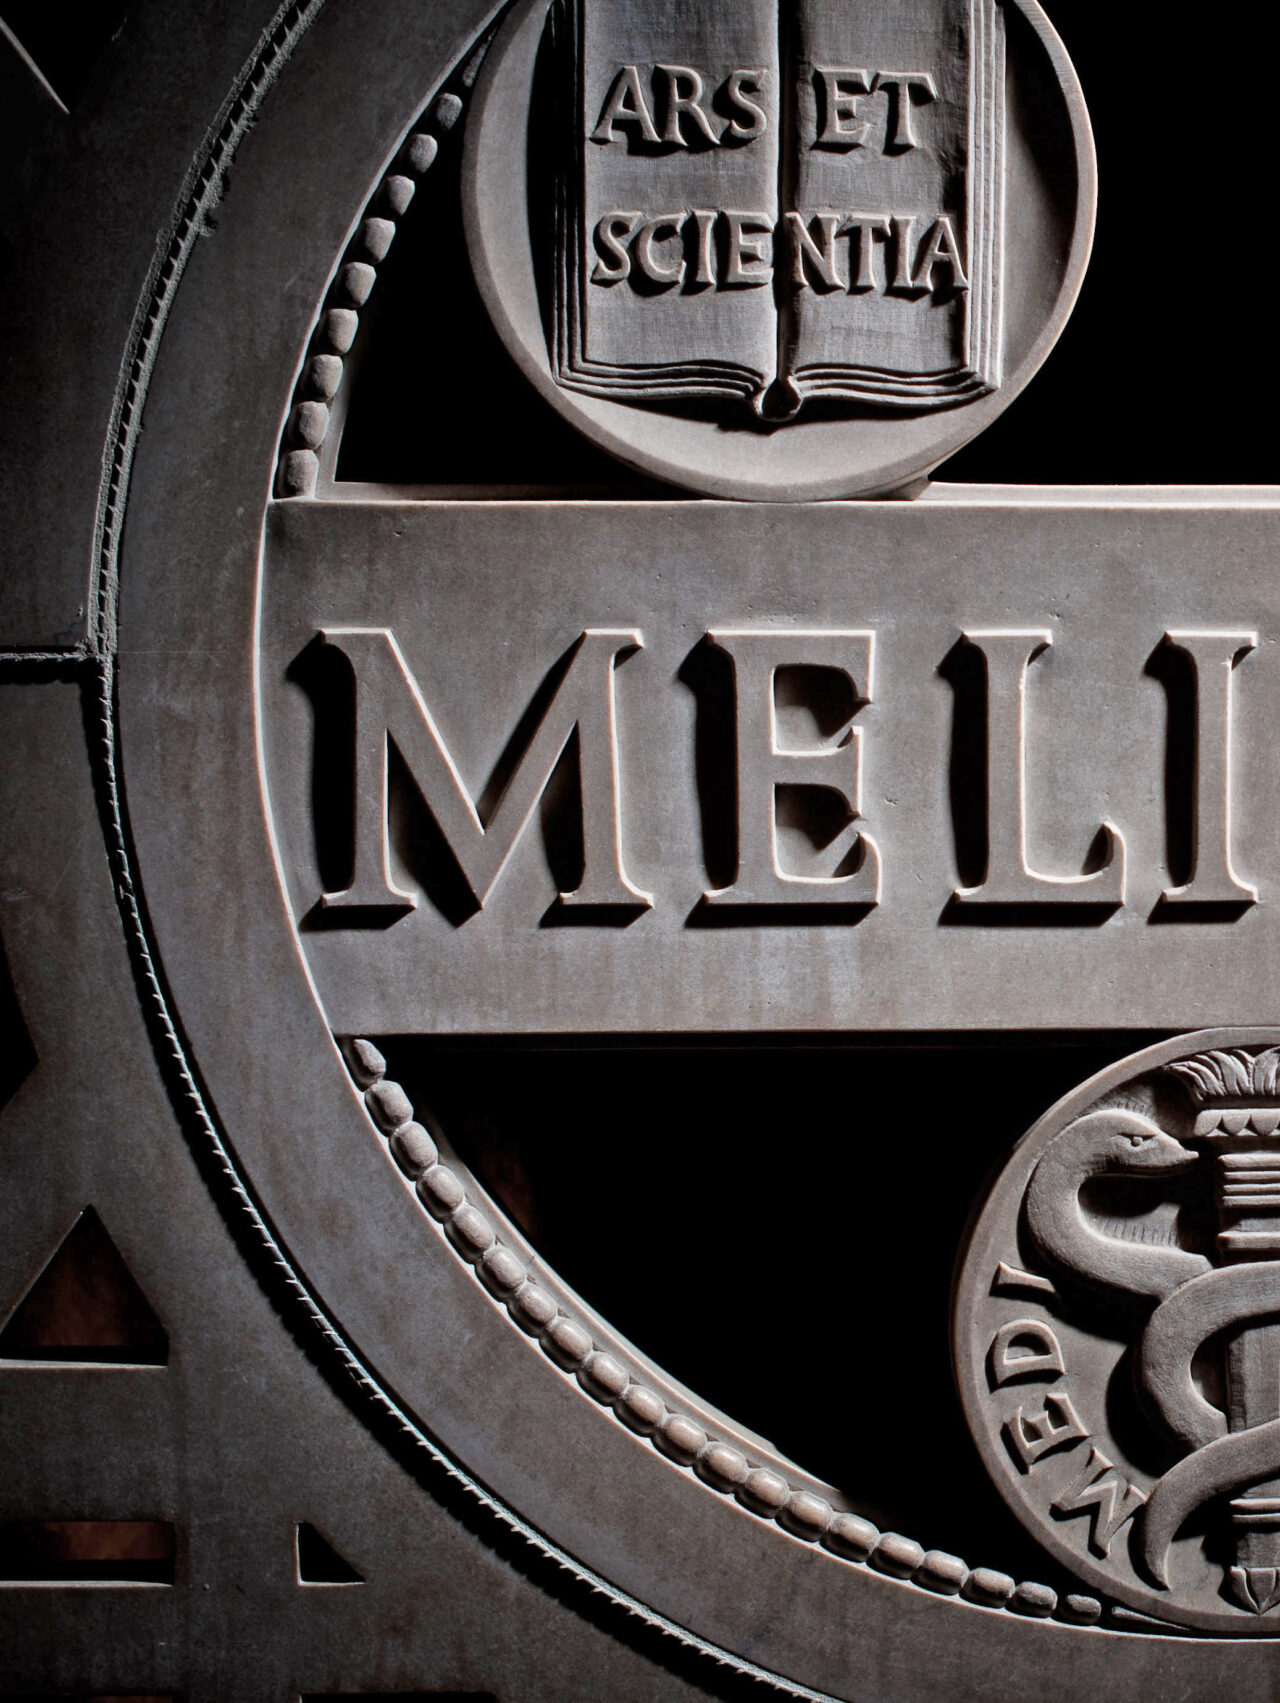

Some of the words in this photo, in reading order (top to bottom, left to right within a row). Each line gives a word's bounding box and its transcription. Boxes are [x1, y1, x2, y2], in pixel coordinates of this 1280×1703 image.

[590, 64, 768, 146] ARS
[813, 67, 938, 148] ET
[591, 210, 969, 291] SCIENTIA
